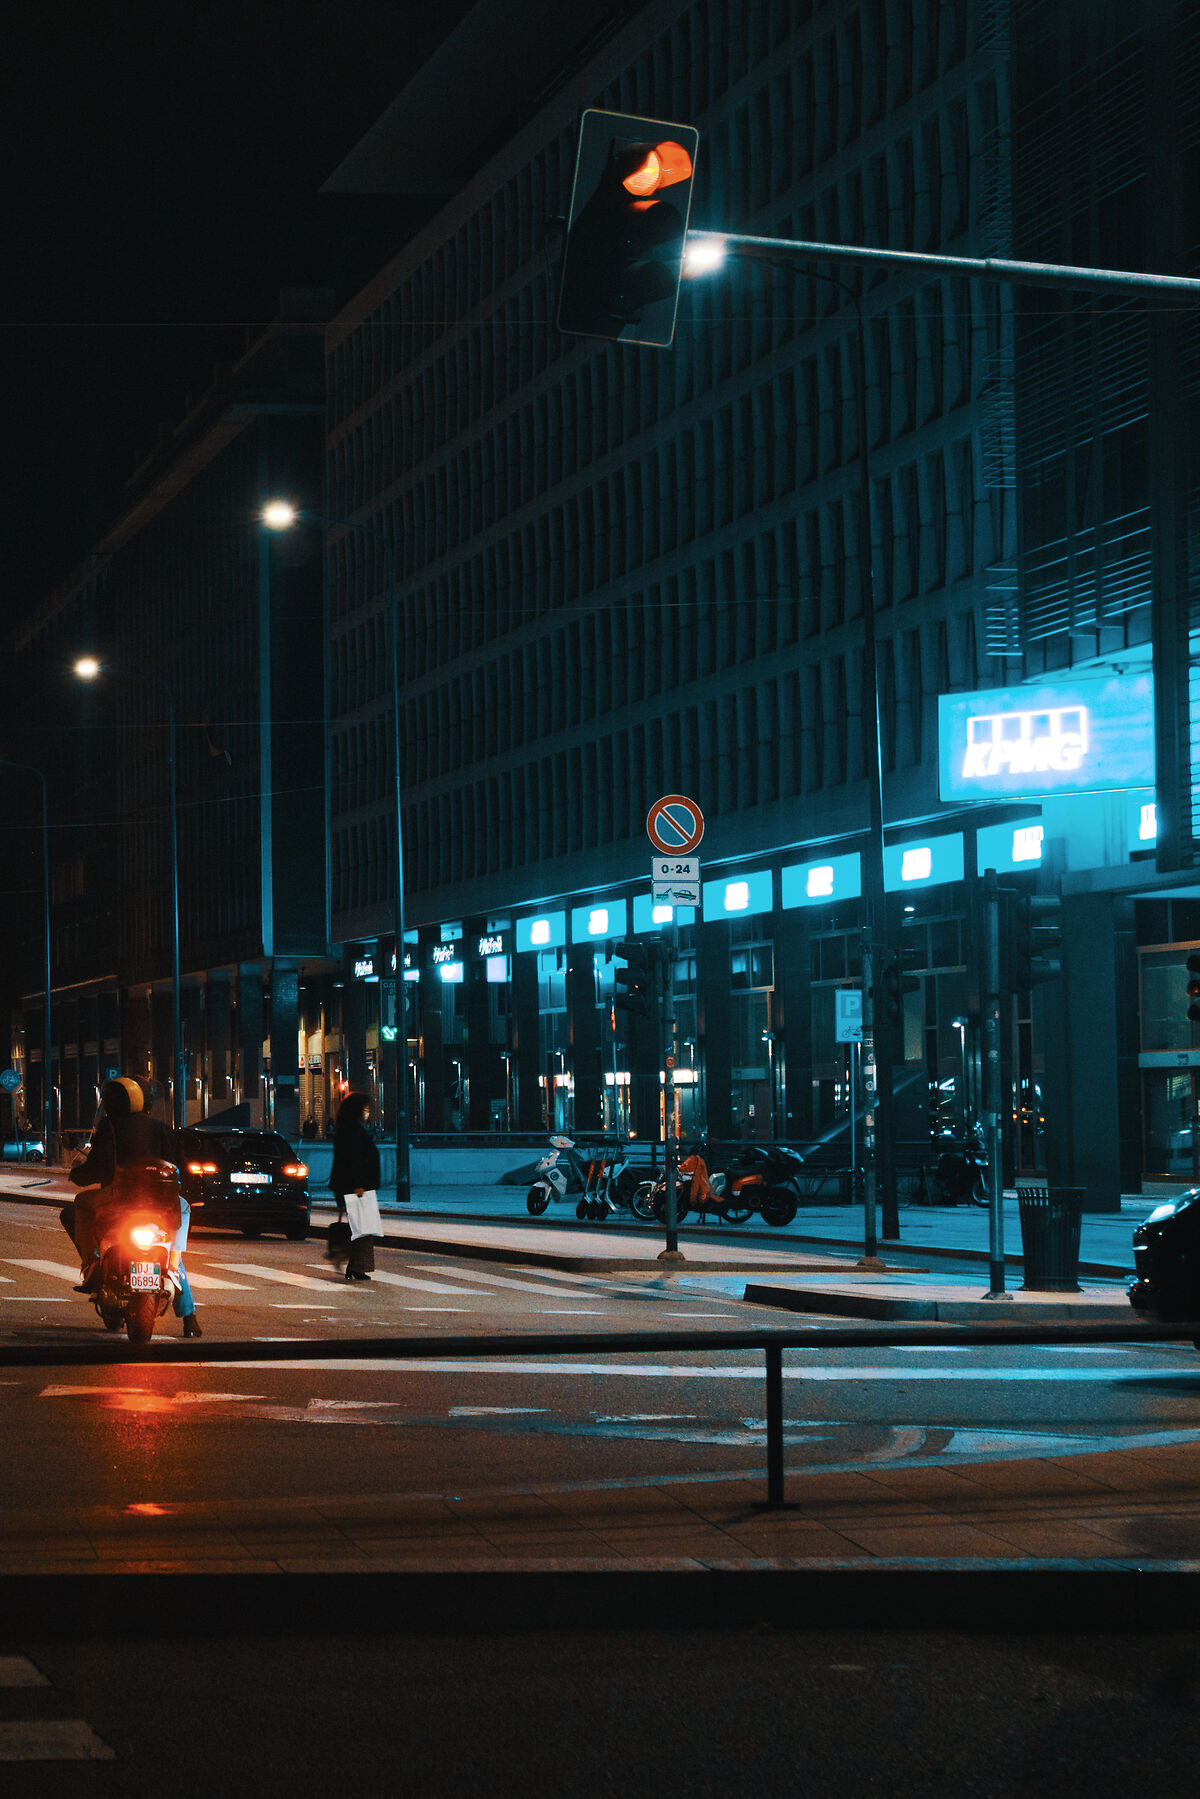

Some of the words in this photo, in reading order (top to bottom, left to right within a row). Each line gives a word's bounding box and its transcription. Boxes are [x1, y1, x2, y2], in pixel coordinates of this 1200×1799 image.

[962, 733, 1084, 778] KPMG
[661, 864, 691, 874] 0-24
[132, 1275, 159, 1287] 06894
